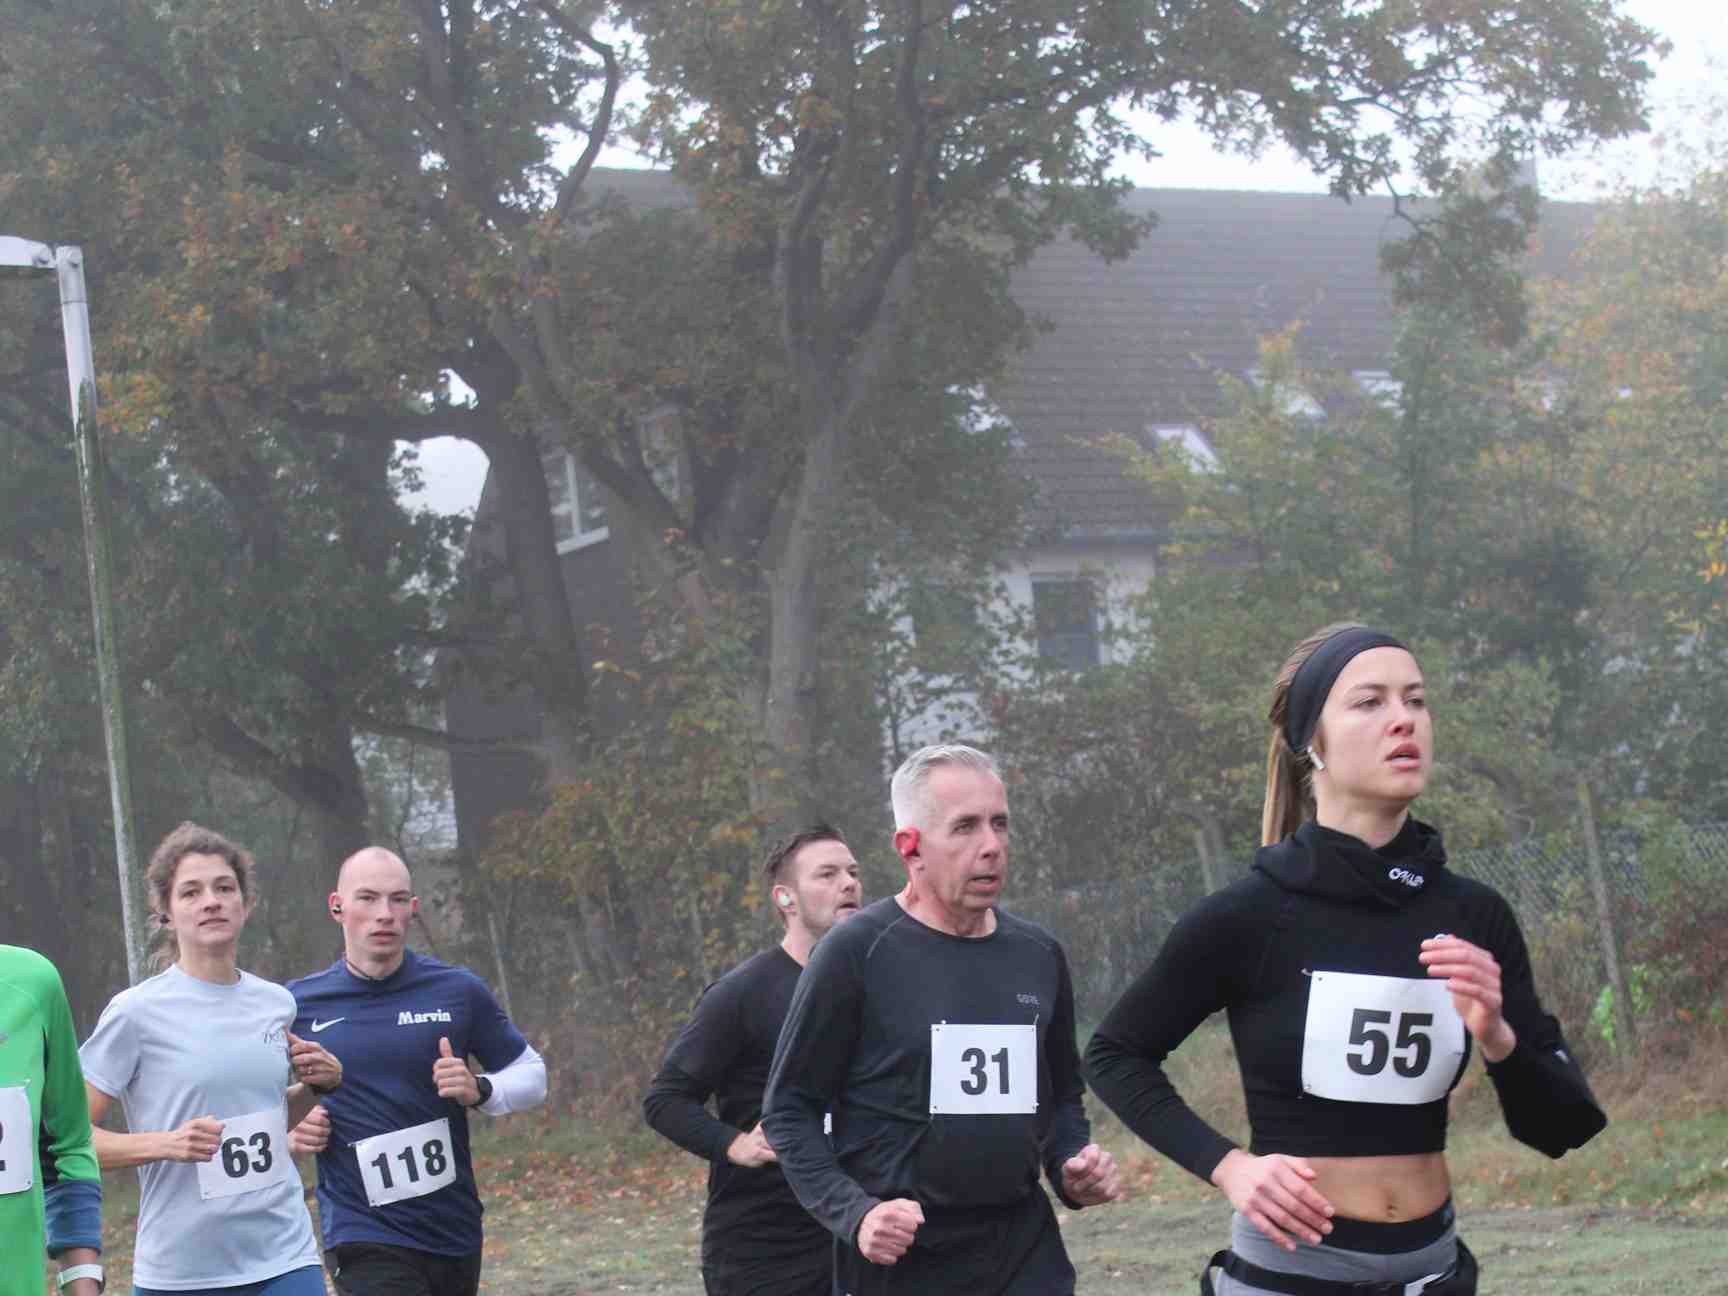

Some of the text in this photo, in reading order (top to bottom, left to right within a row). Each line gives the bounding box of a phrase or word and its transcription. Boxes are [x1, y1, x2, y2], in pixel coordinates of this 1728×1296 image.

[397, 1008, 452, 1025] Marvin
[1346, 1008, 1434, 1078] 55
[960, 1047, 1010, 1095] 31
[221, 1131, 272, 1178] 63
[371, 1139, 447, 1189] 118
